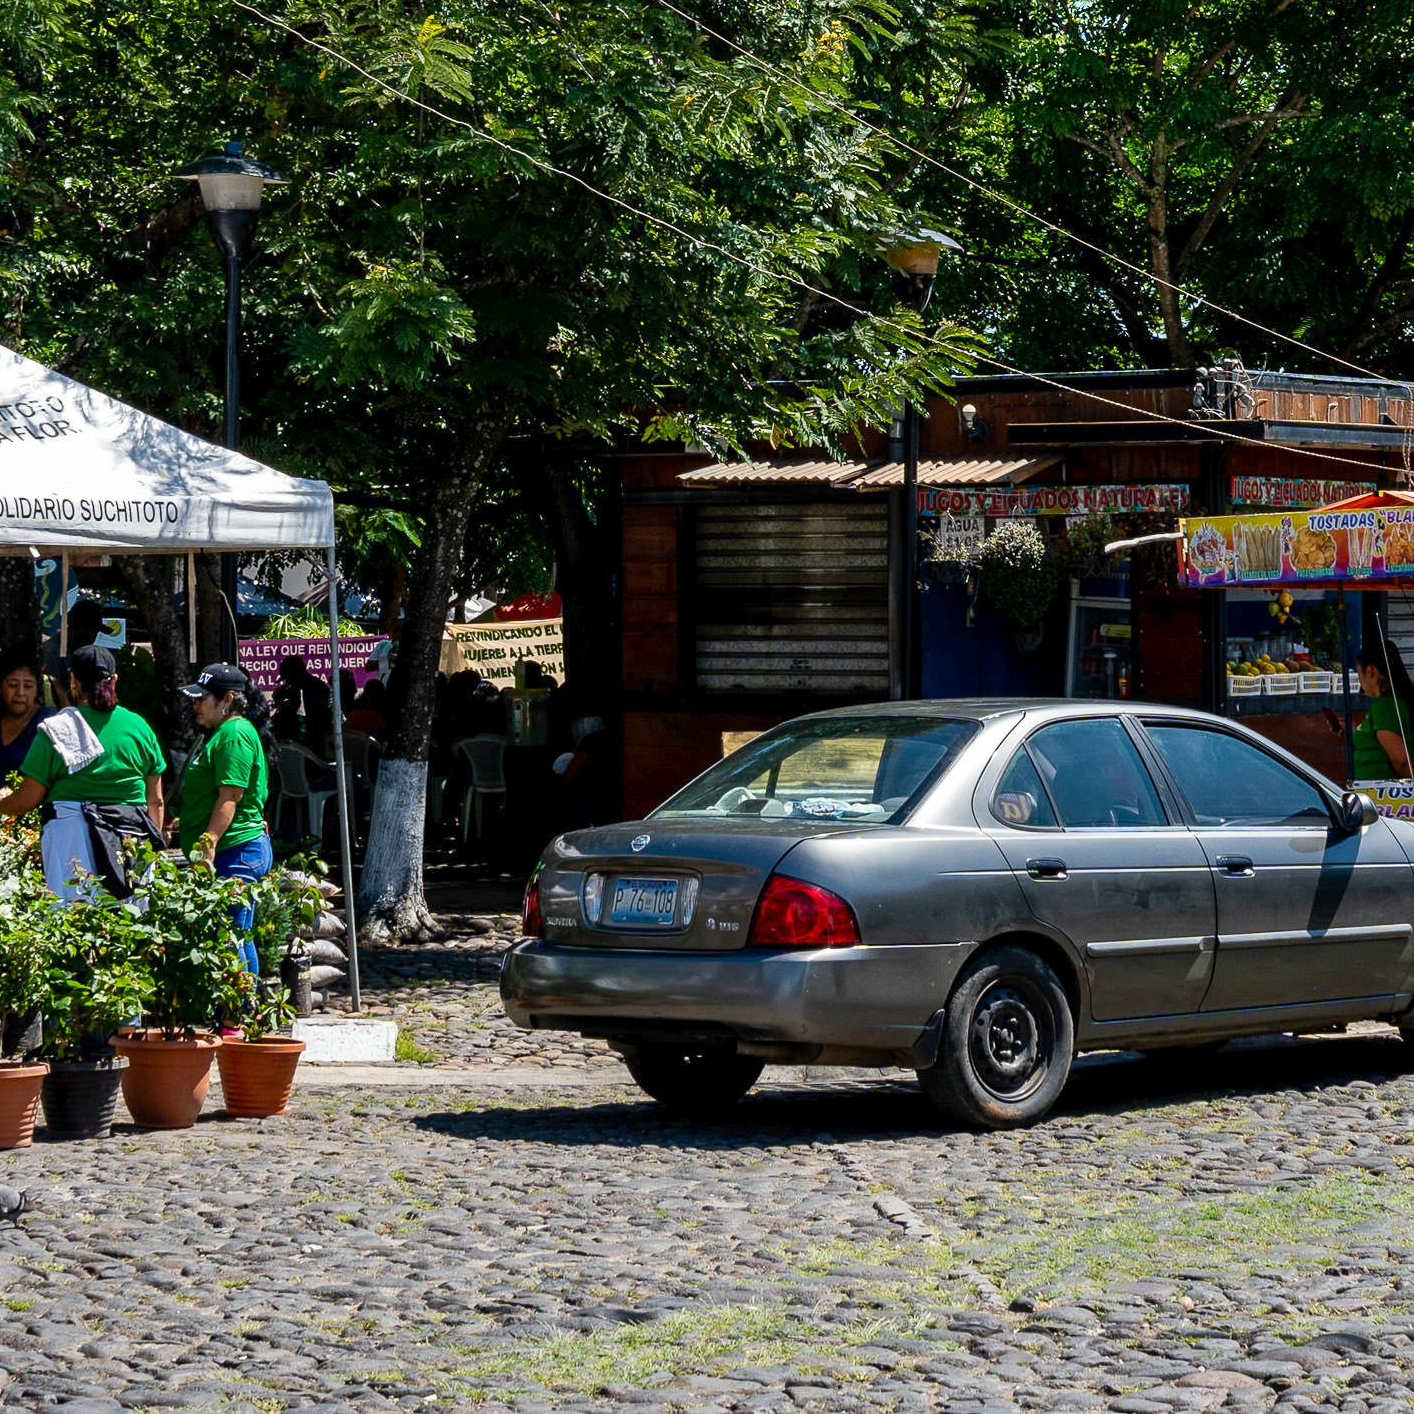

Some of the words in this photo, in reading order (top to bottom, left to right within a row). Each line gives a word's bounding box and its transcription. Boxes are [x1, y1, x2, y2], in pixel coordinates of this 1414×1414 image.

[917, 489, 971, 511] JUGOS
[990, 488, 1079, 510] LICUADOS
[1084, 487, 1187, 509] NATURALES
[1232, 479, 1262, 499] JUGOS
[80, 499, 178, 524] SUCHITOTO
[1309, 513, 1375, 531] TOSTADAS
[546, 624, 558, 636] EL
[256, 645, 278, 657] LEY
[281, 644, 305, 656] QUE
[615, 888, 624, 912] P
